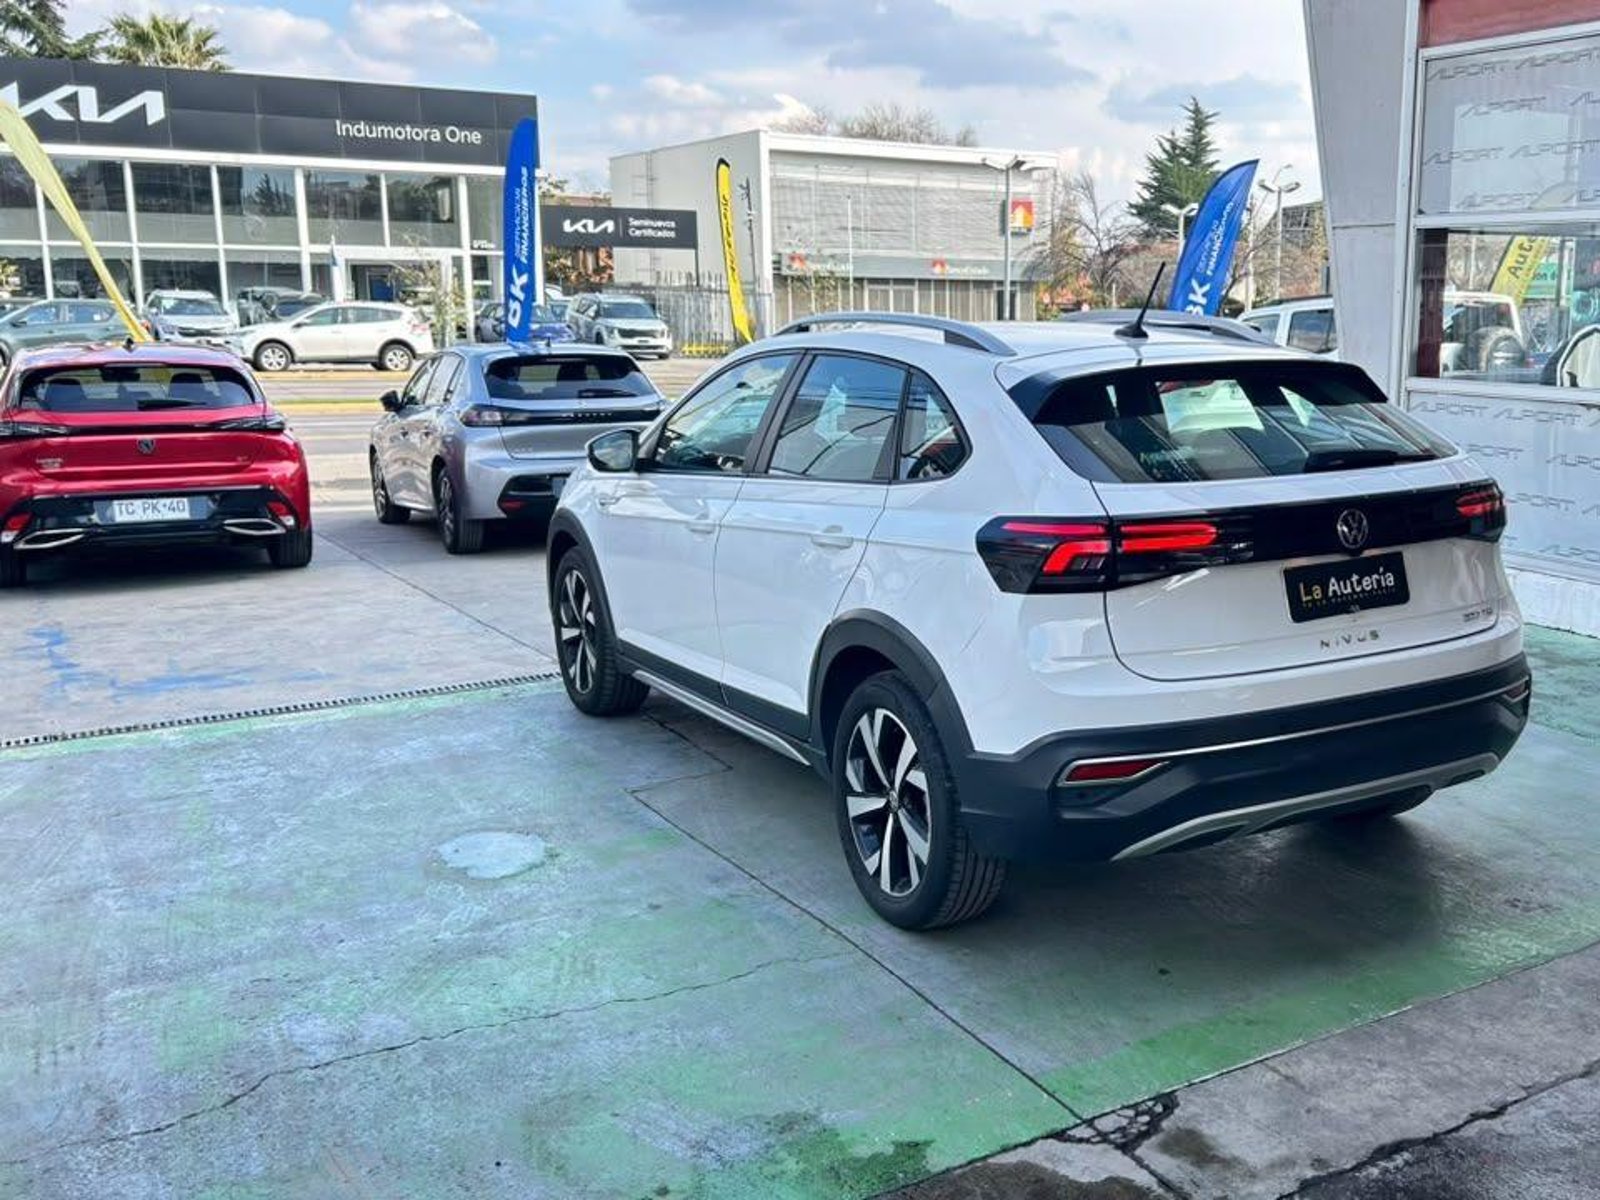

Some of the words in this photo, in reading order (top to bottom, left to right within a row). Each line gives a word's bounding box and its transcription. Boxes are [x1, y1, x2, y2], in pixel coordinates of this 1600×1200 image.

[0, 80, 165, 126] KIA
[335, 119, 441, 142] Indumotora
[445, 125, 482, 145] One
[563, 218, 615, 234] KIA
[1299, 581, 1323, 602] La
